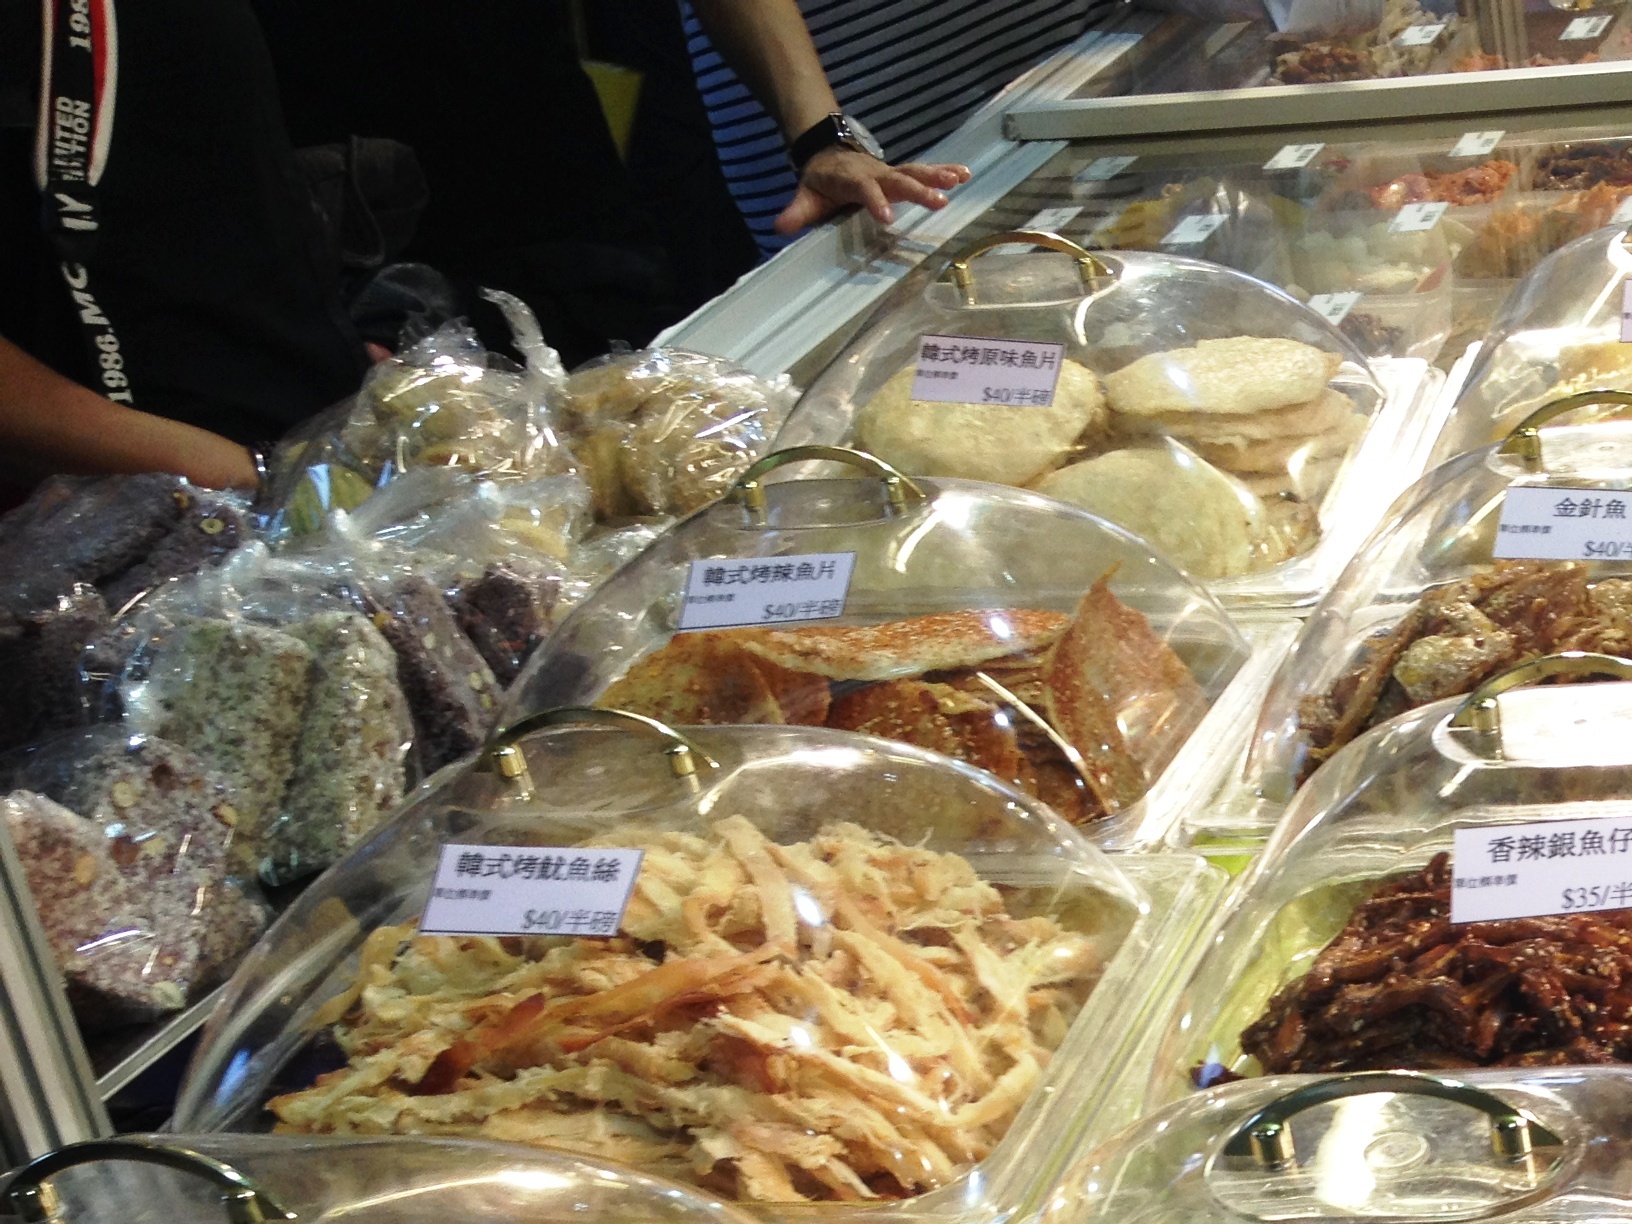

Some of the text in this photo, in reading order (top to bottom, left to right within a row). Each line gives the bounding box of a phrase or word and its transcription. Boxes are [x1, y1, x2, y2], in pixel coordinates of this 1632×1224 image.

[921, 342, 1056, 371] 韓式烤原味魚片
[1553, 497, 1626, 519] 金針魚
[456, 851, 621, 883] 韓式烤魷魚絲
[521, 908, 617, 933] $40/半磅
